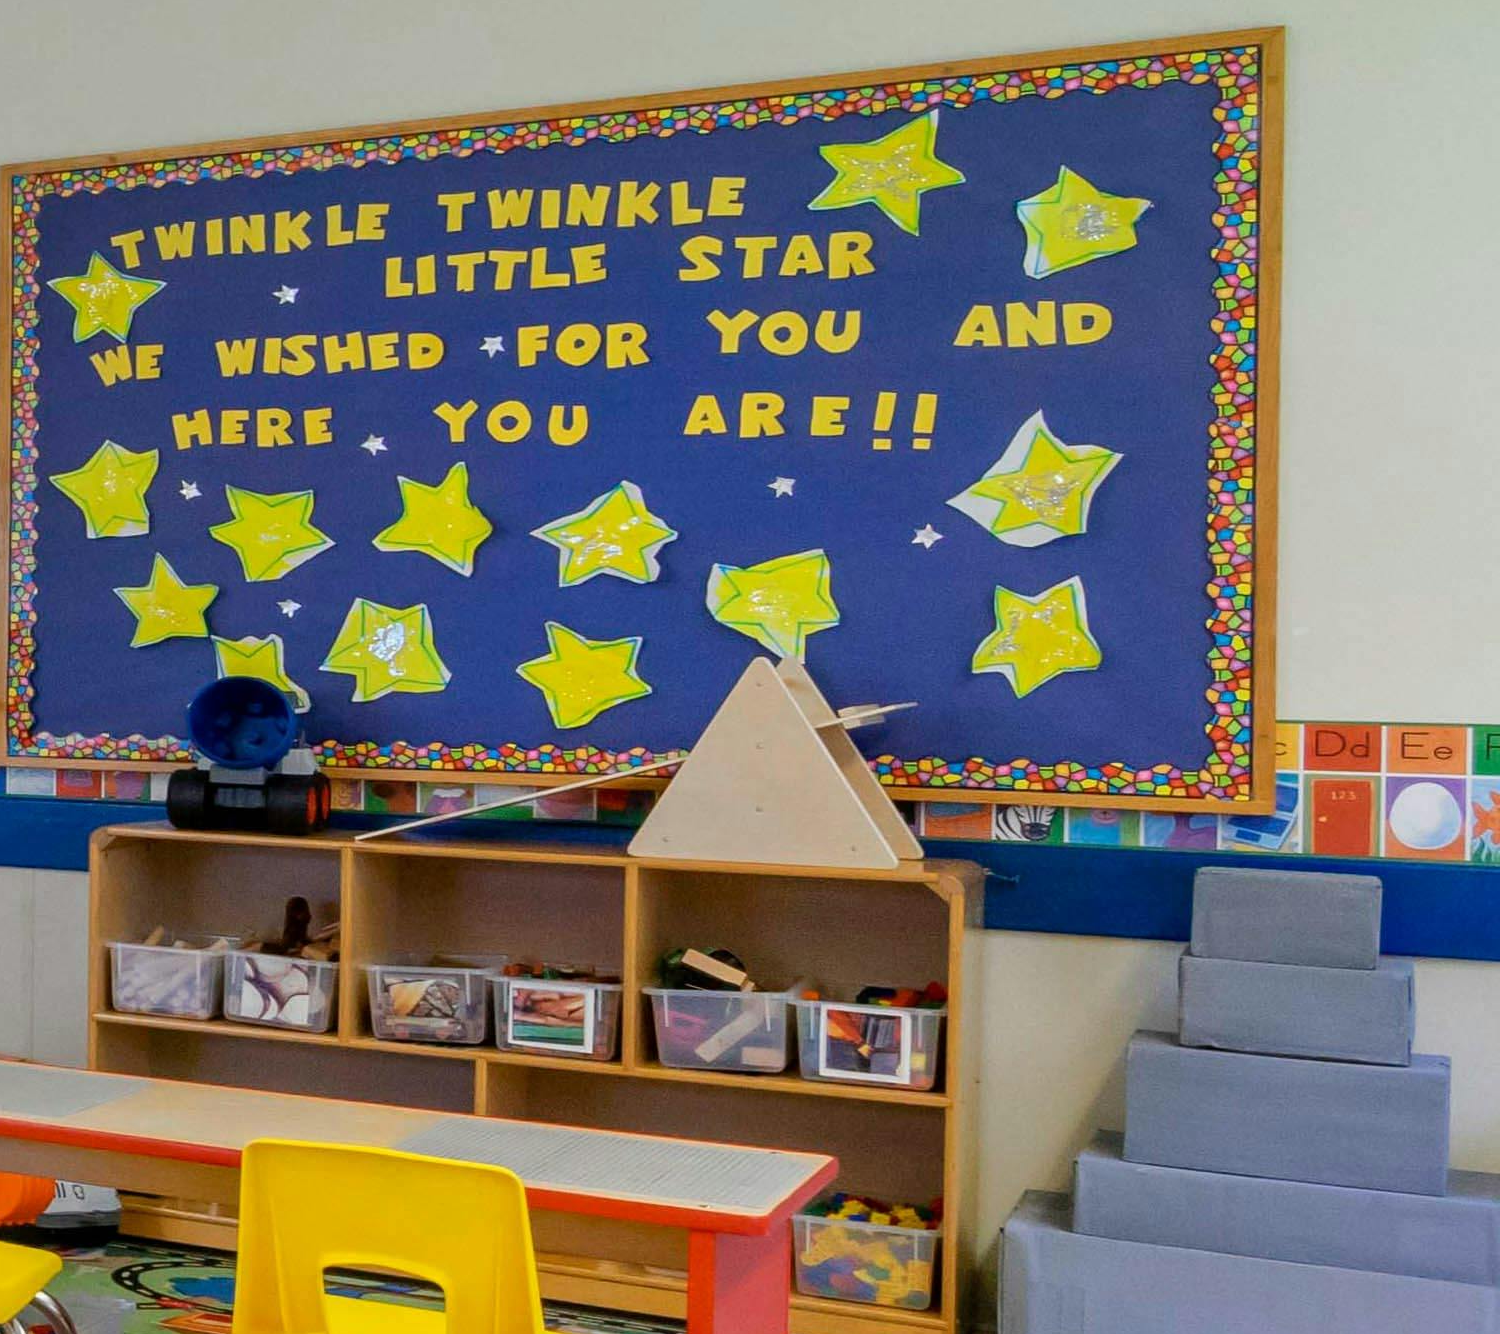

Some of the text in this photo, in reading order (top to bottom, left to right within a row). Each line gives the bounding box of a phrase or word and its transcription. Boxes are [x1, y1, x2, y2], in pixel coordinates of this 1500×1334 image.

[110, 177, 747, 269] TWINKLE TWINKLE
[384, 231, 876, 299] LITTLE STAR
[90, 300, 1112, 387] WE WISHED FOR YOU AND
[171, 391, 938, 450] HERE YOU ARE!!
[1315, 729, 1370, 759] Dd
[1400, 731, 1454, 761] Ee
